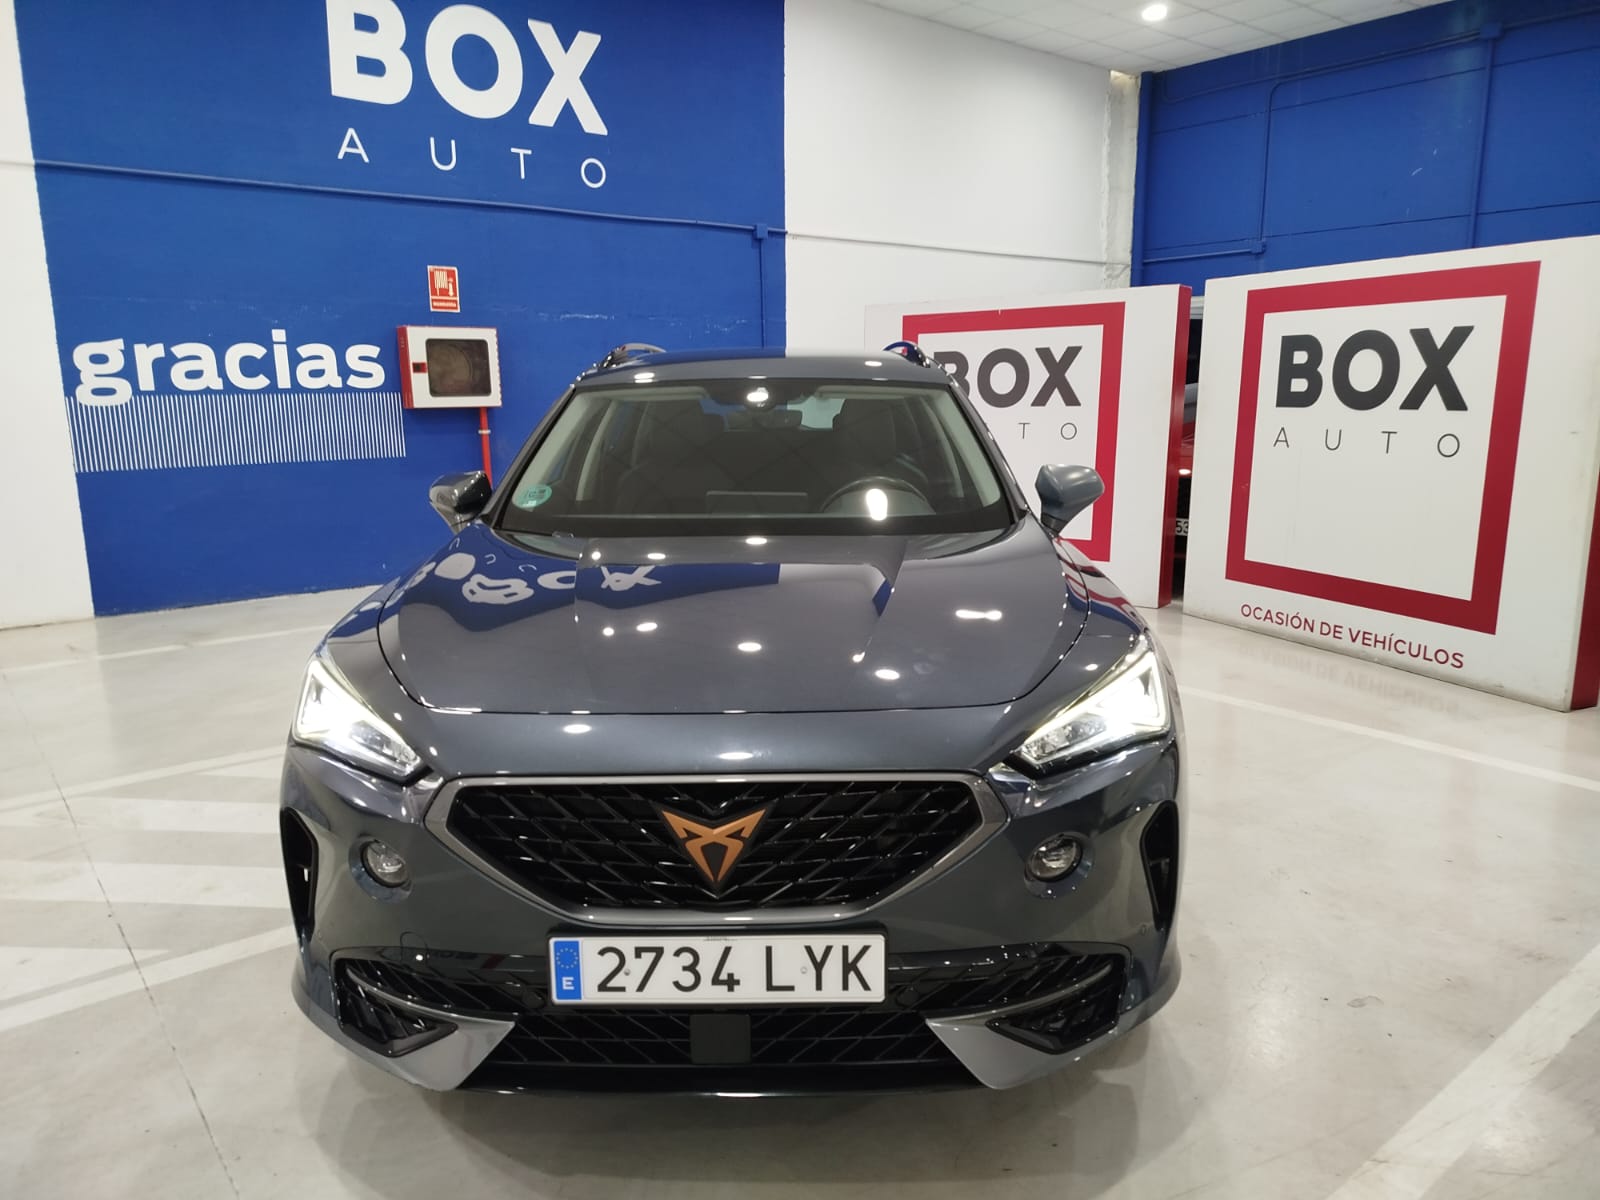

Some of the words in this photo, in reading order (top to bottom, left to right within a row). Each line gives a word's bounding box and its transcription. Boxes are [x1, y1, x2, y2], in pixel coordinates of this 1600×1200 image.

[326, 0, 608, 136] BOX
[337, 127, 607, 189] AUTO
[72, 328, 386, 407] gracias
[933, 345, 1083, 409] BOX
[1275, 325, 1475, 412] BOX
[1017, 422, 1078, 441] TO
[1273, 426, 1460, 458] AUTO
[1176, 520, 1188, 534] 53
[1240, 603, 1316, 633] OCASIÓN
[1319, 621, 1344, 640] DE
[1348, 627, 1465, 669] VEHÍCULOS
[561, 976, 575, 990] E
[596, 946, 741, 993] 2734
[765, 944, 873, 993] LYK
